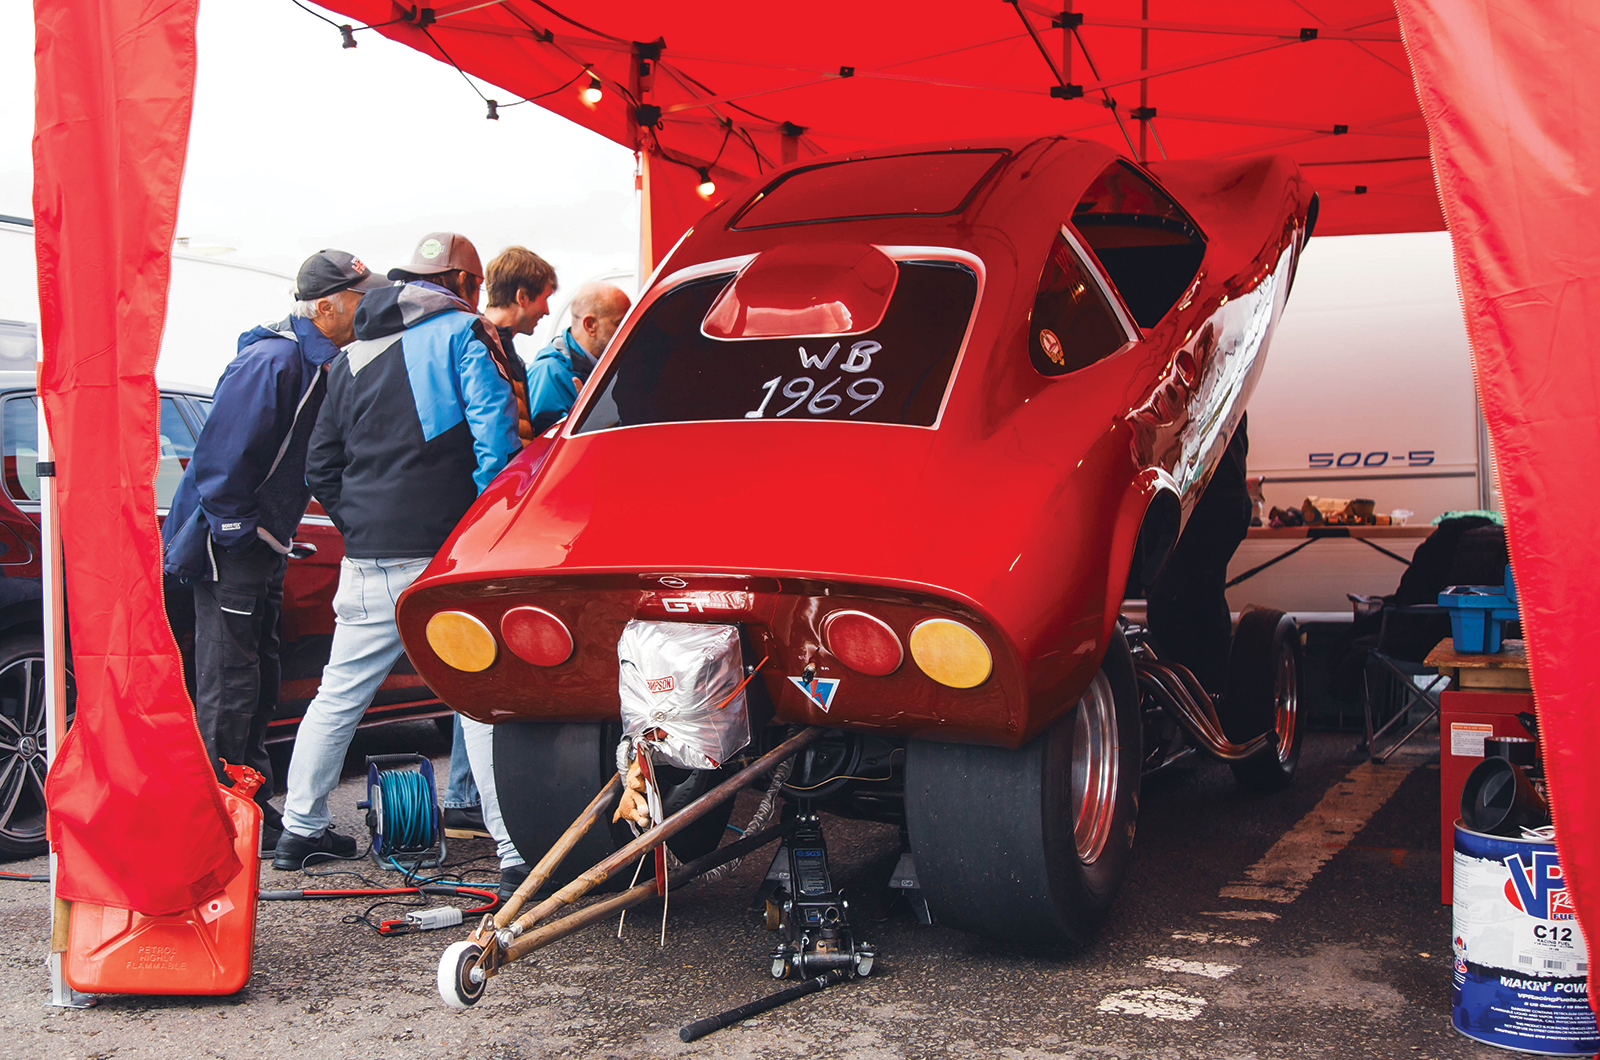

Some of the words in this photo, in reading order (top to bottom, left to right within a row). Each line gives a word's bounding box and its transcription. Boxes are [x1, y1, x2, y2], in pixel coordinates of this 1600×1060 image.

[744, 375, 885, 419] 1969
[1308, 450, 1435, 468] 500-5
[661, 598, 709, 613] GT
[646, 678, 672, 691] MPSON
[1503, 851, 1568, 920] VP
[1533, 924, 1573, 942] C12
[138, 946, 177, 955] PETROL
[139, 954, 175, 962] HIGHLY
[126, 961, 187, 971] FLAMMABLE
[1500, 975, 1552, 992] MAKIN'
[1553, 982, 1588, 993] POW
